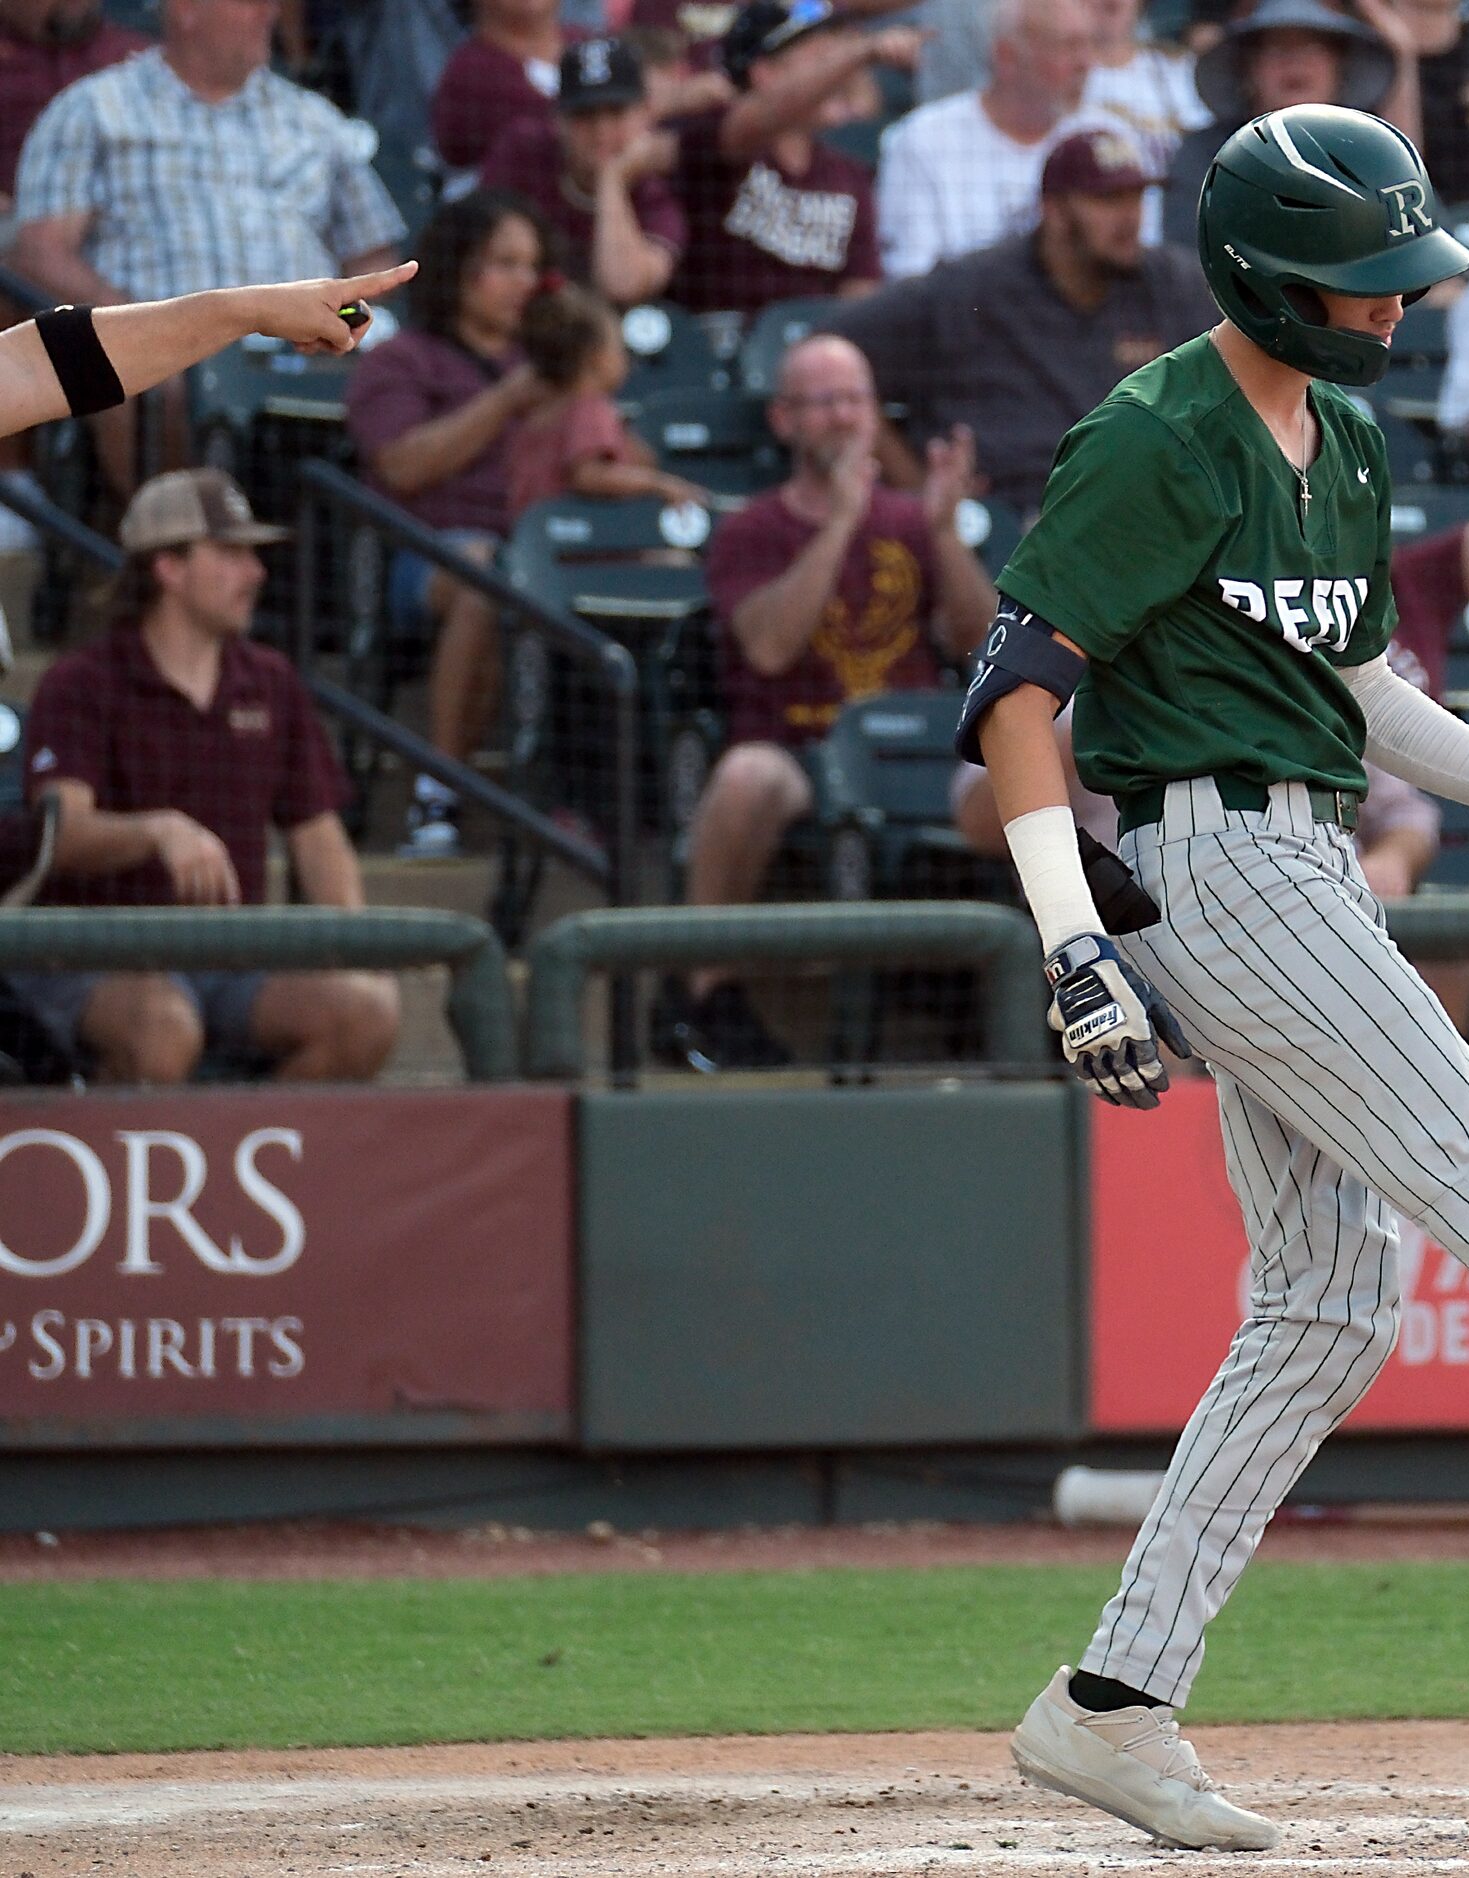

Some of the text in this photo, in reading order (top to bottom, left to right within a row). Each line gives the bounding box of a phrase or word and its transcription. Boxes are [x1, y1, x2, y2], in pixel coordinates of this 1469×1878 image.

[1378, 178, 1433, 240] R
[1218, 578, 1368, 653] REED
[1069, 1006, 1118, 1041] Franklin
[28, 1309, 304, 1380] SPIRITS
